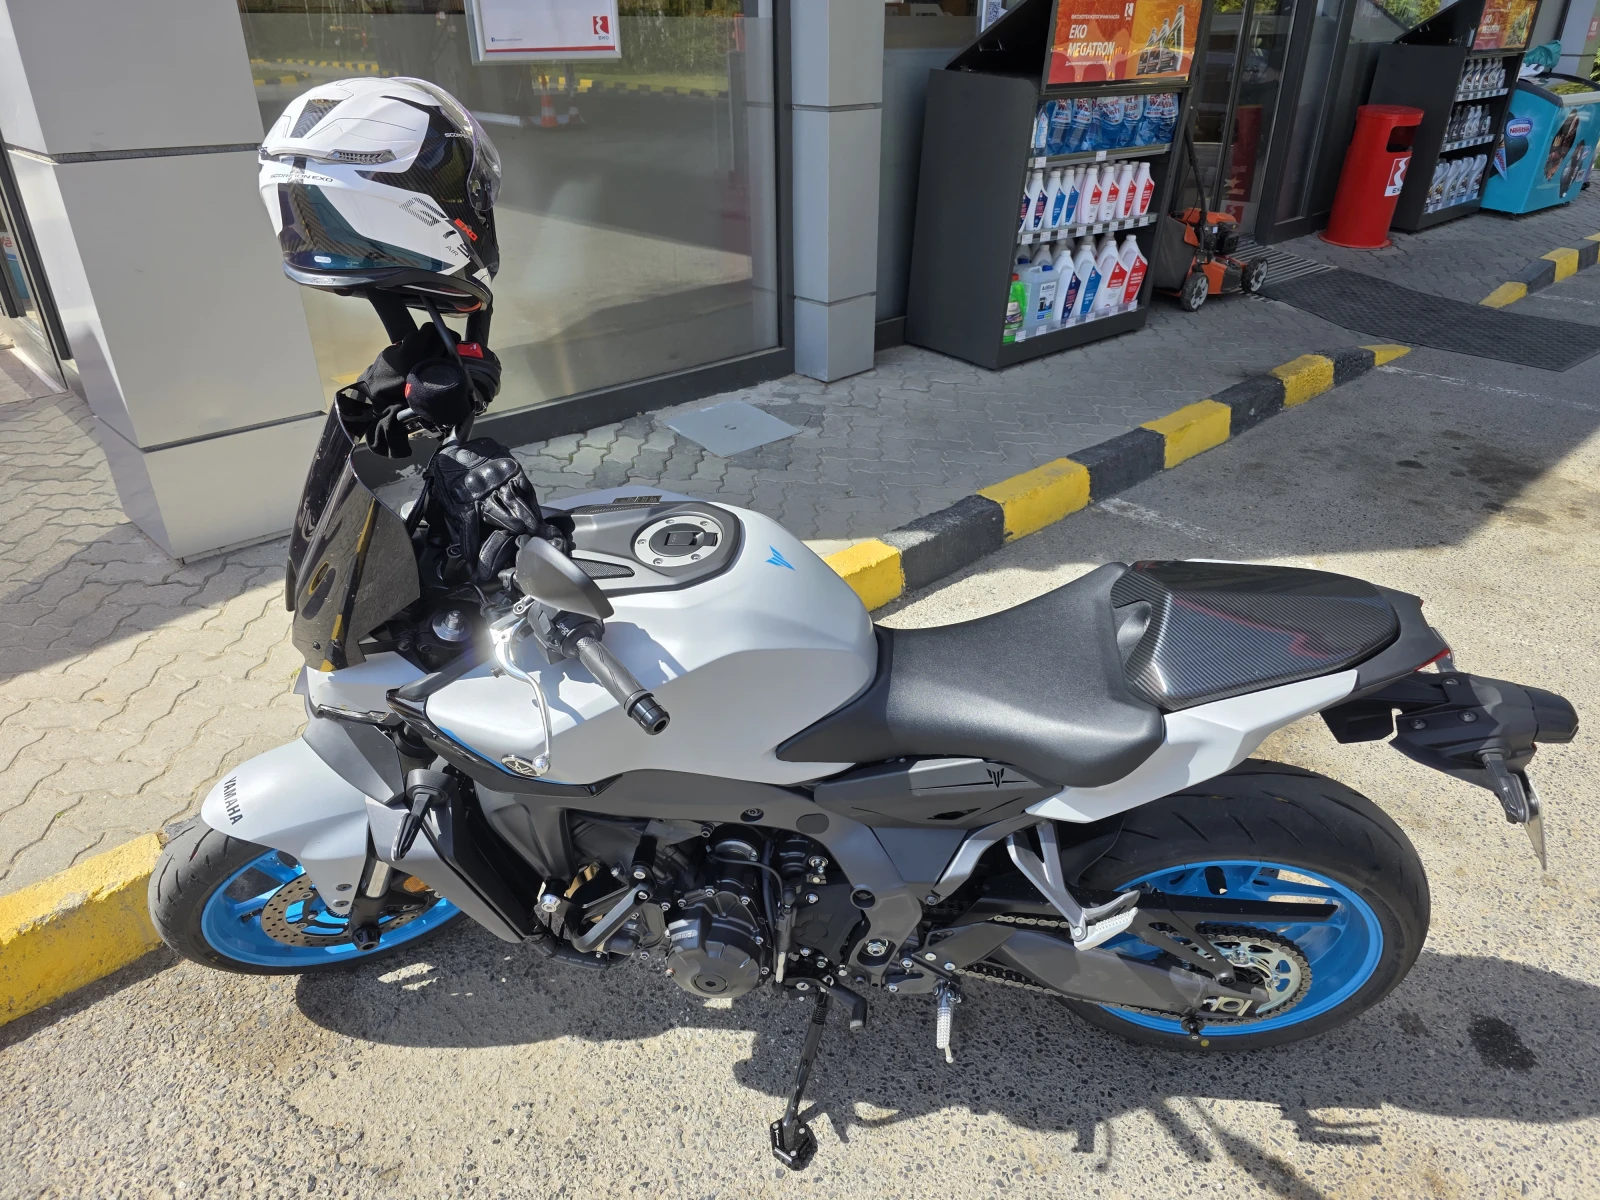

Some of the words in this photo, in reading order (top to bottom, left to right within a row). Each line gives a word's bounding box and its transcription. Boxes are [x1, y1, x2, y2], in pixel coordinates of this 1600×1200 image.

[1069, 24, 1087, 38] EKO
[1067, 42, 1115, 56] MEGATRON
[454, 218, 478, 241] EXO
[445, 245, 459, 257] AIR
[223, 776, 243, 826] YAMAHA
